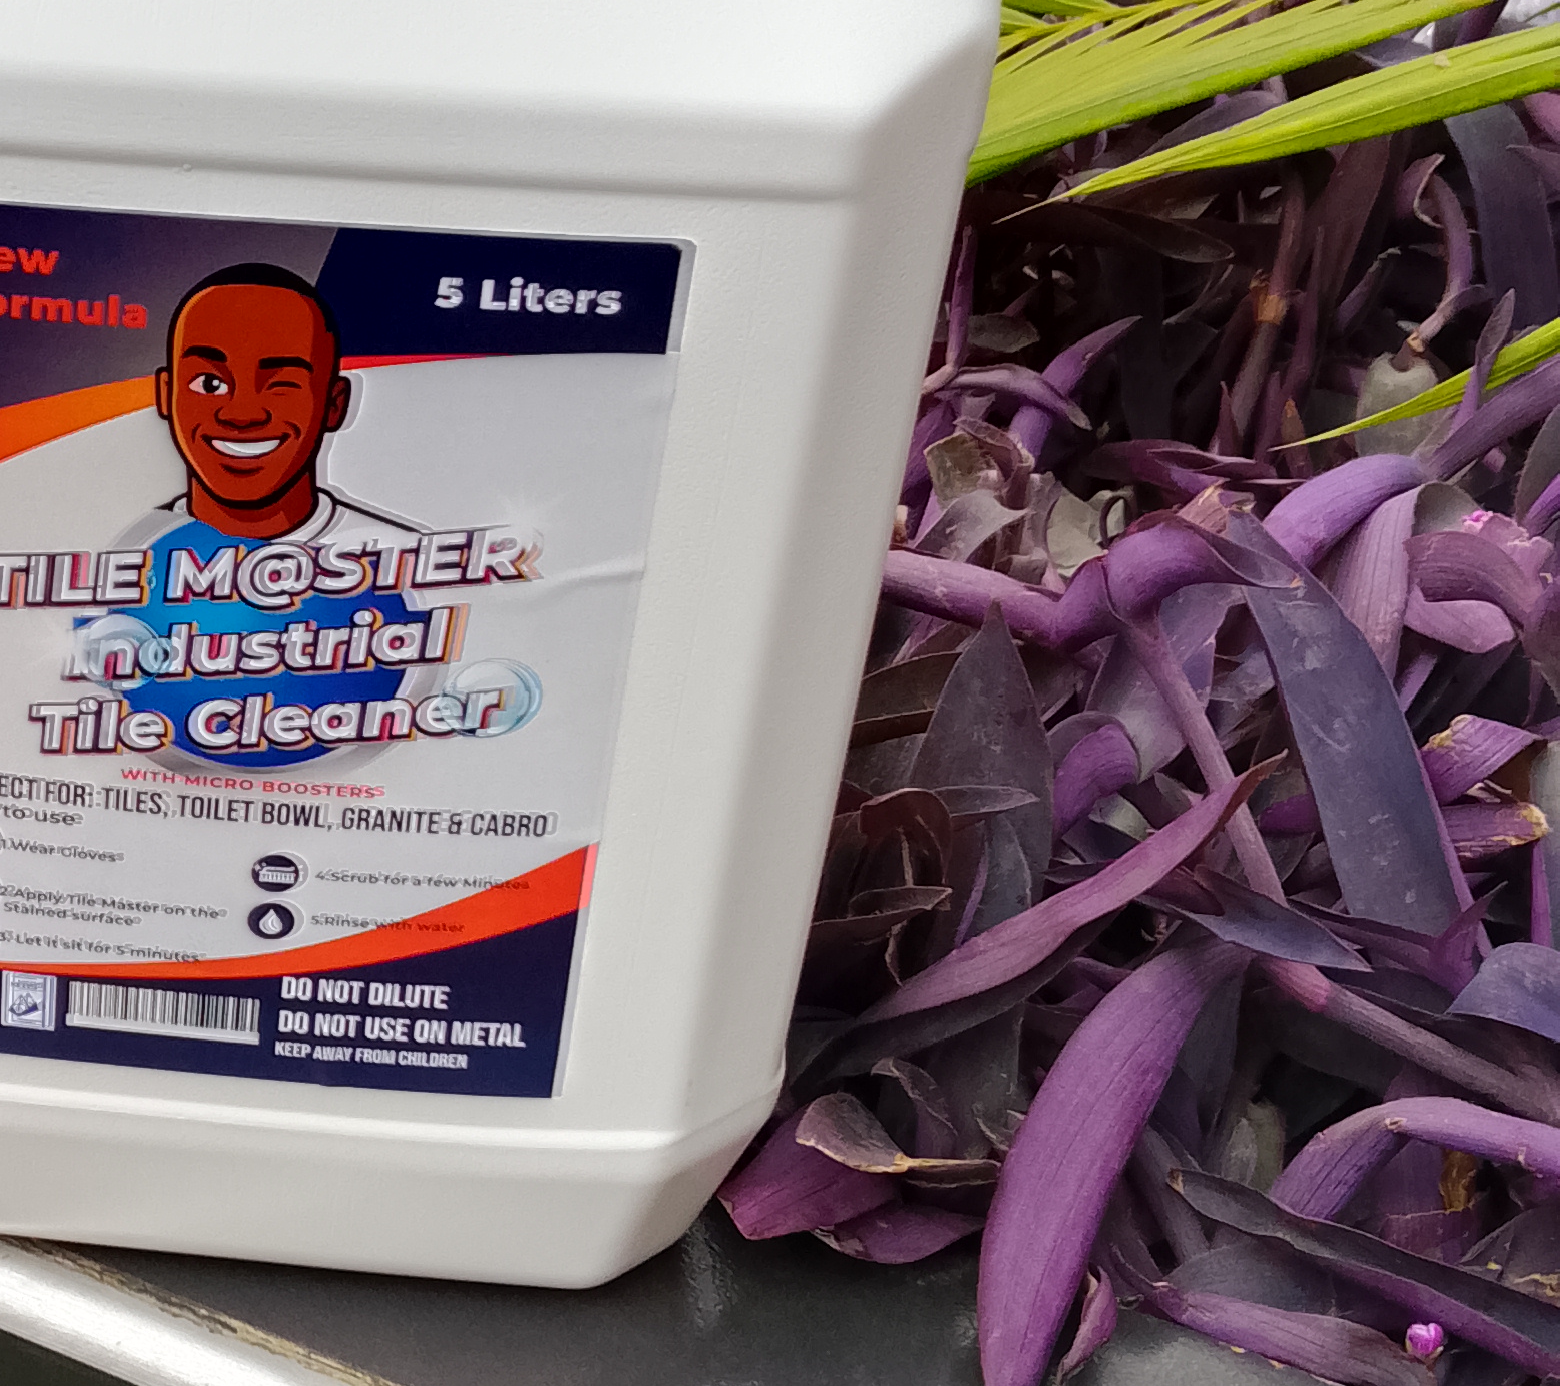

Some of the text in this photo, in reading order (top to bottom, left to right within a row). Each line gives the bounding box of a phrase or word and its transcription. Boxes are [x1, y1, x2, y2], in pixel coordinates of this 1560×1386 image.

[434, 276, 622, 315] 5 Liters
[163, 526, 537, 612] M@STER
[61, 604, 464, 684] Industrial
[28, 687, 512, 756] Tile Cleaner
[121, 768, 379, 799] WITH MICRO BOOSTERS
[3, 805, 27, 820] to
[34, 809, 77, 826] use
[44, 780, 94, 809] FOR:
[102, 786, 168, 819] TILES,
[177, 793, 255, 823] TOILET
[261, 799, 333, 833] BOWL,
[341, 805, 440, 835] GRANITE
[448, 812, 463, 836] &
[470, 811, 551, 838] CABRO
[61, 845, 118, 863] Gloves
[384, 873, 409, 886] for
[412, 878, 421, 887] a
[427, 875, 458, 888] few
[102, 898, 159, 913] Master
[164, 905, 186, 916] on
[130, 948, 201, 963] minutes
[281, 976, 451, 1010] DO NOT DILUTE
[278, 1009, 527, 1048] DO NOT USE ON METAL
[274, 1041, 469, 1070] KEEP AWAY FROM CHILDREN
